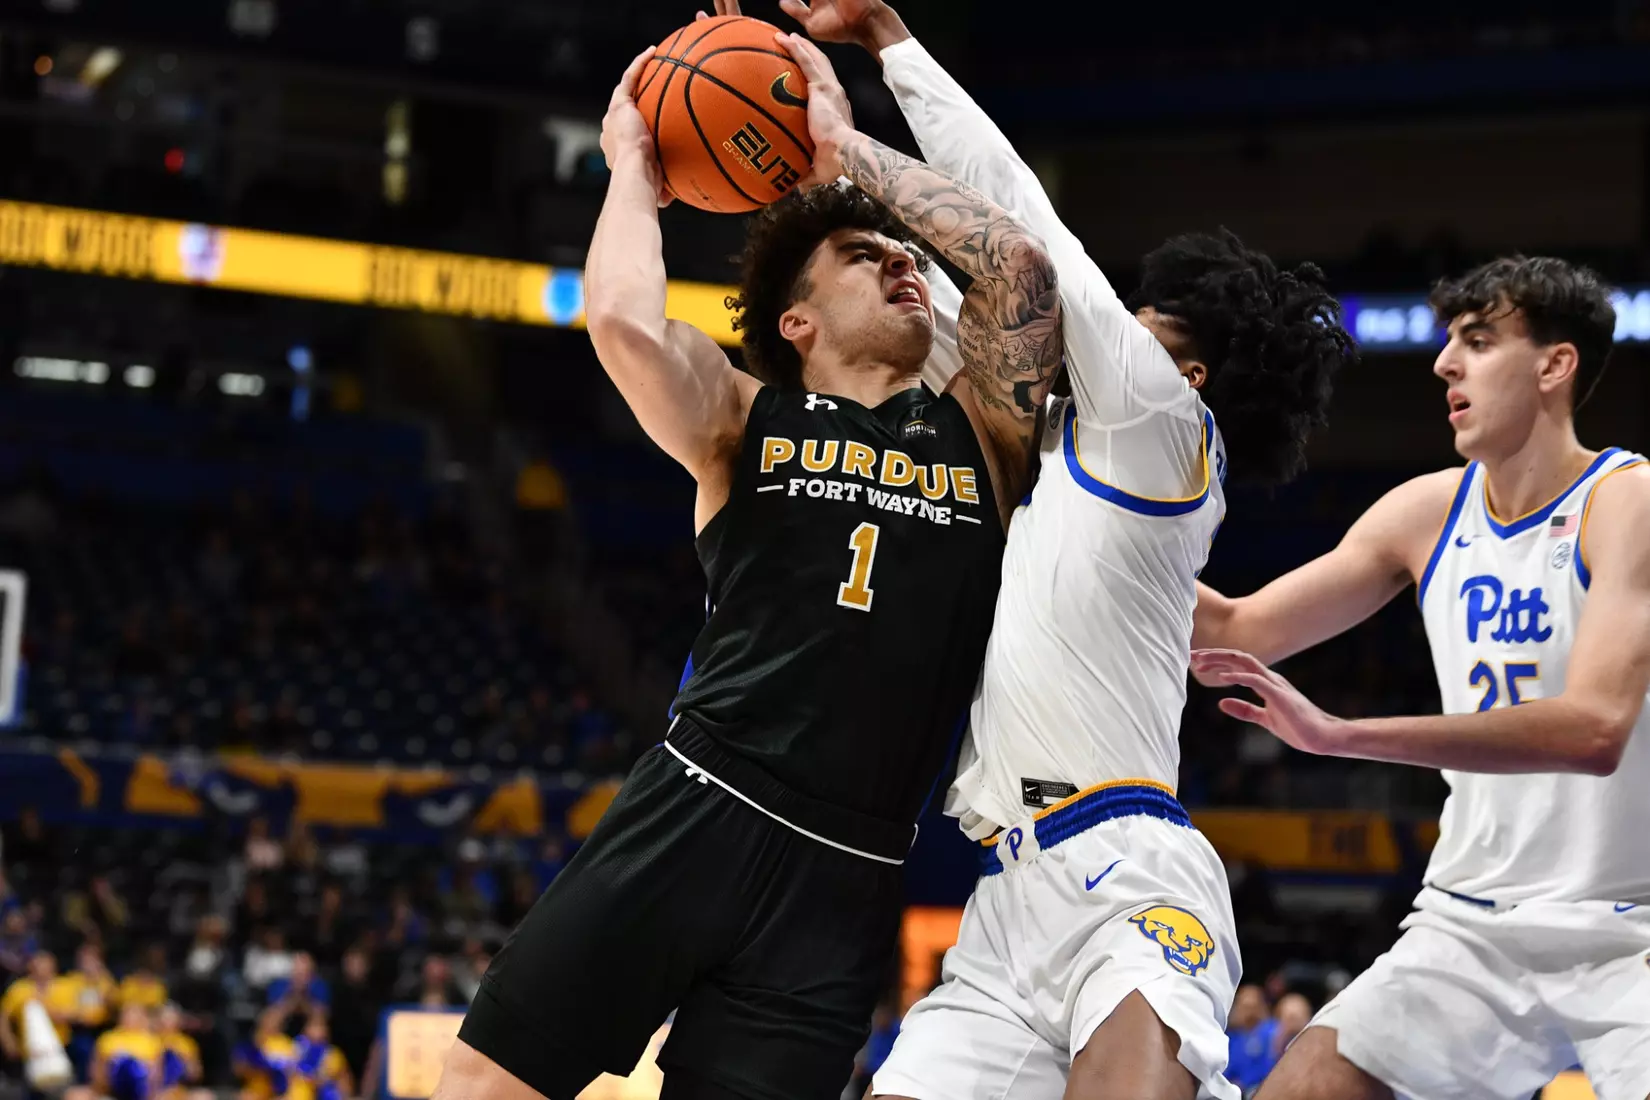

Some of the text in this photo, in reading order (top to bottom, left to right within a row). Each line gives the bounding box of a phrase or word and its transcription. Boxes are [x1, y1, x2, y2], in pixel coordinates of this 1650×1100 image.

[729, 121, 800, 193] ELITE
[760, 437, 980, 504] PURDUE
[788, 478, 952, 525] FORT WAYNE
[836, 521, 880, 612] 1
[1460, 575, 1553, 644] Pitt
